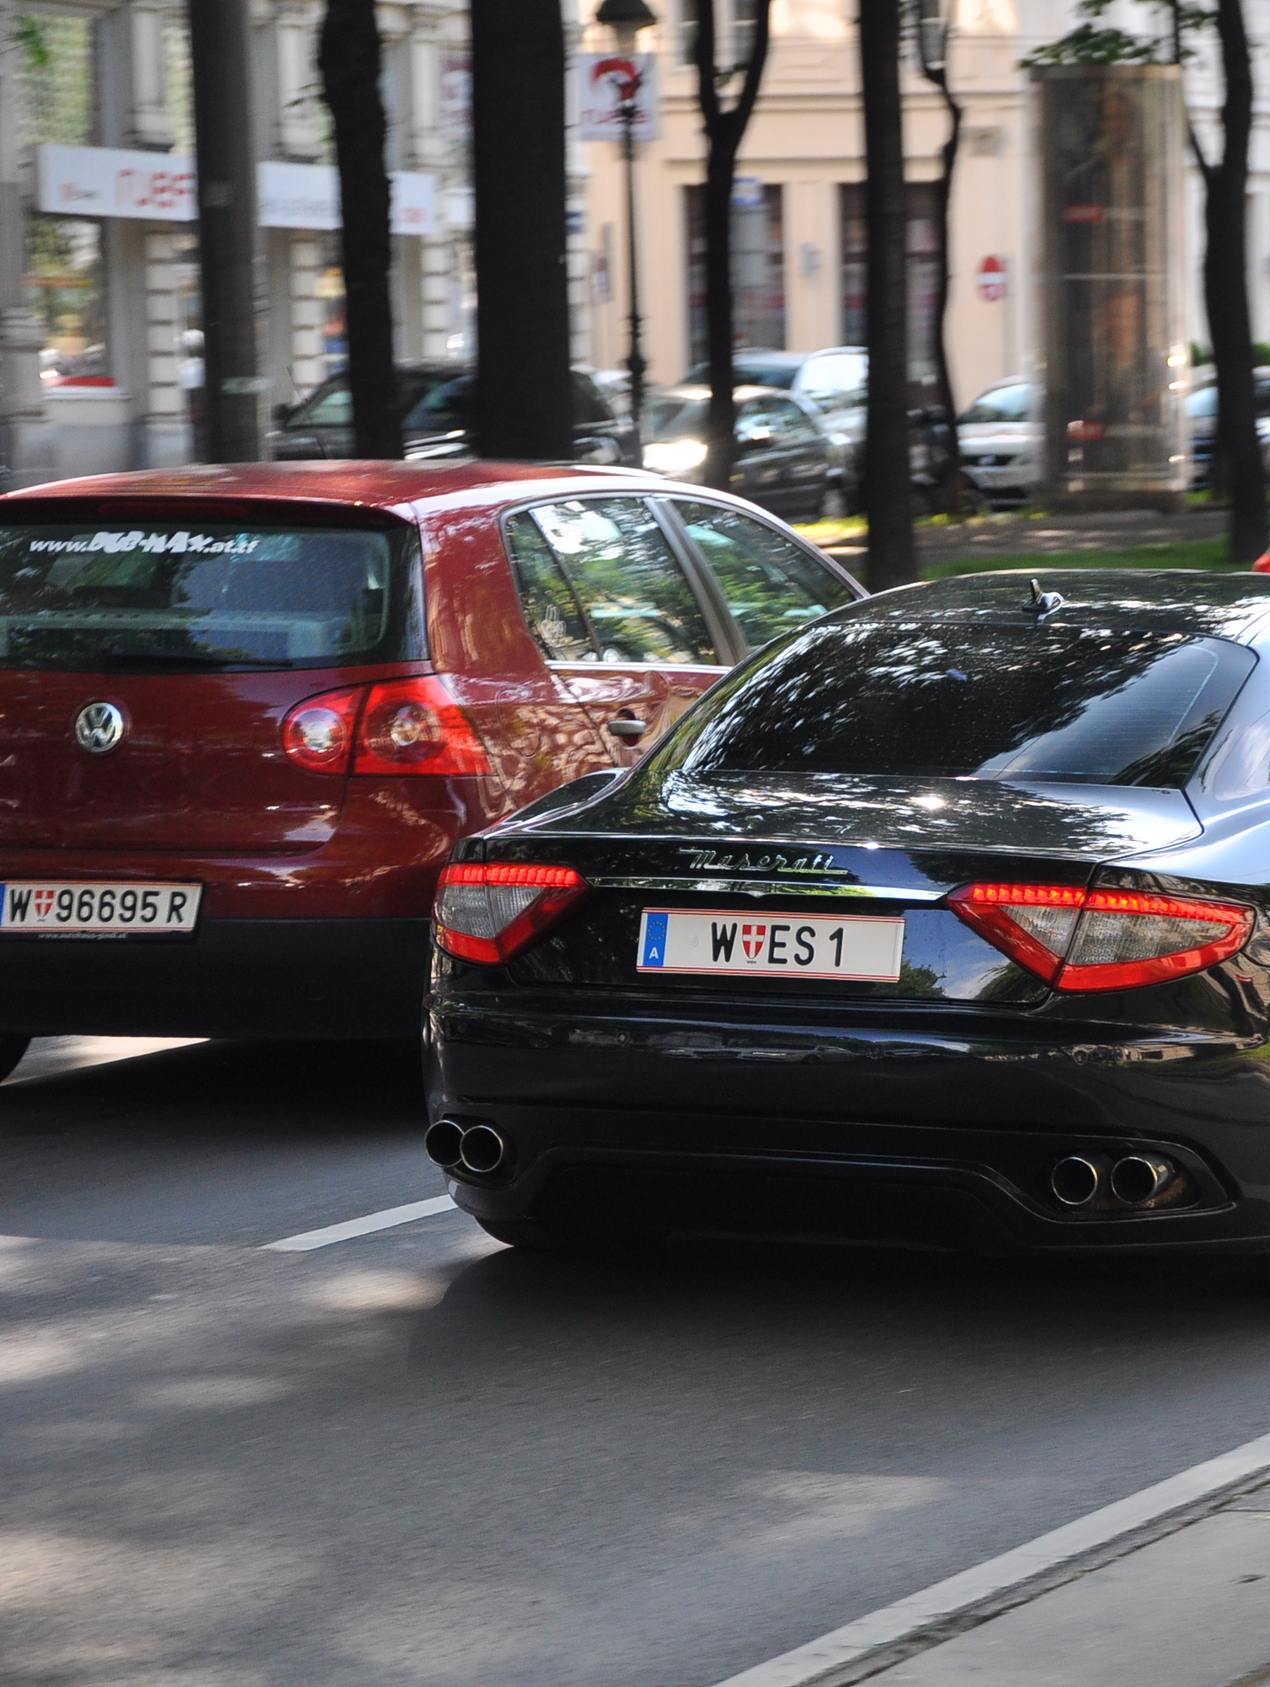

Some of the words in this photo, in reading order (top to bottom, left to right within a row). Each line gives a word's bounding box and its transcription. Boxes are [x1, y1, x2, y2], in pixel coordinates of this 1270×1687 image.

[679, 848, 849, 876] Maserati
[56, 888, 161, 923] 96695
[166, 890, 188, 924] R
[649, 946, 660, 960] A
